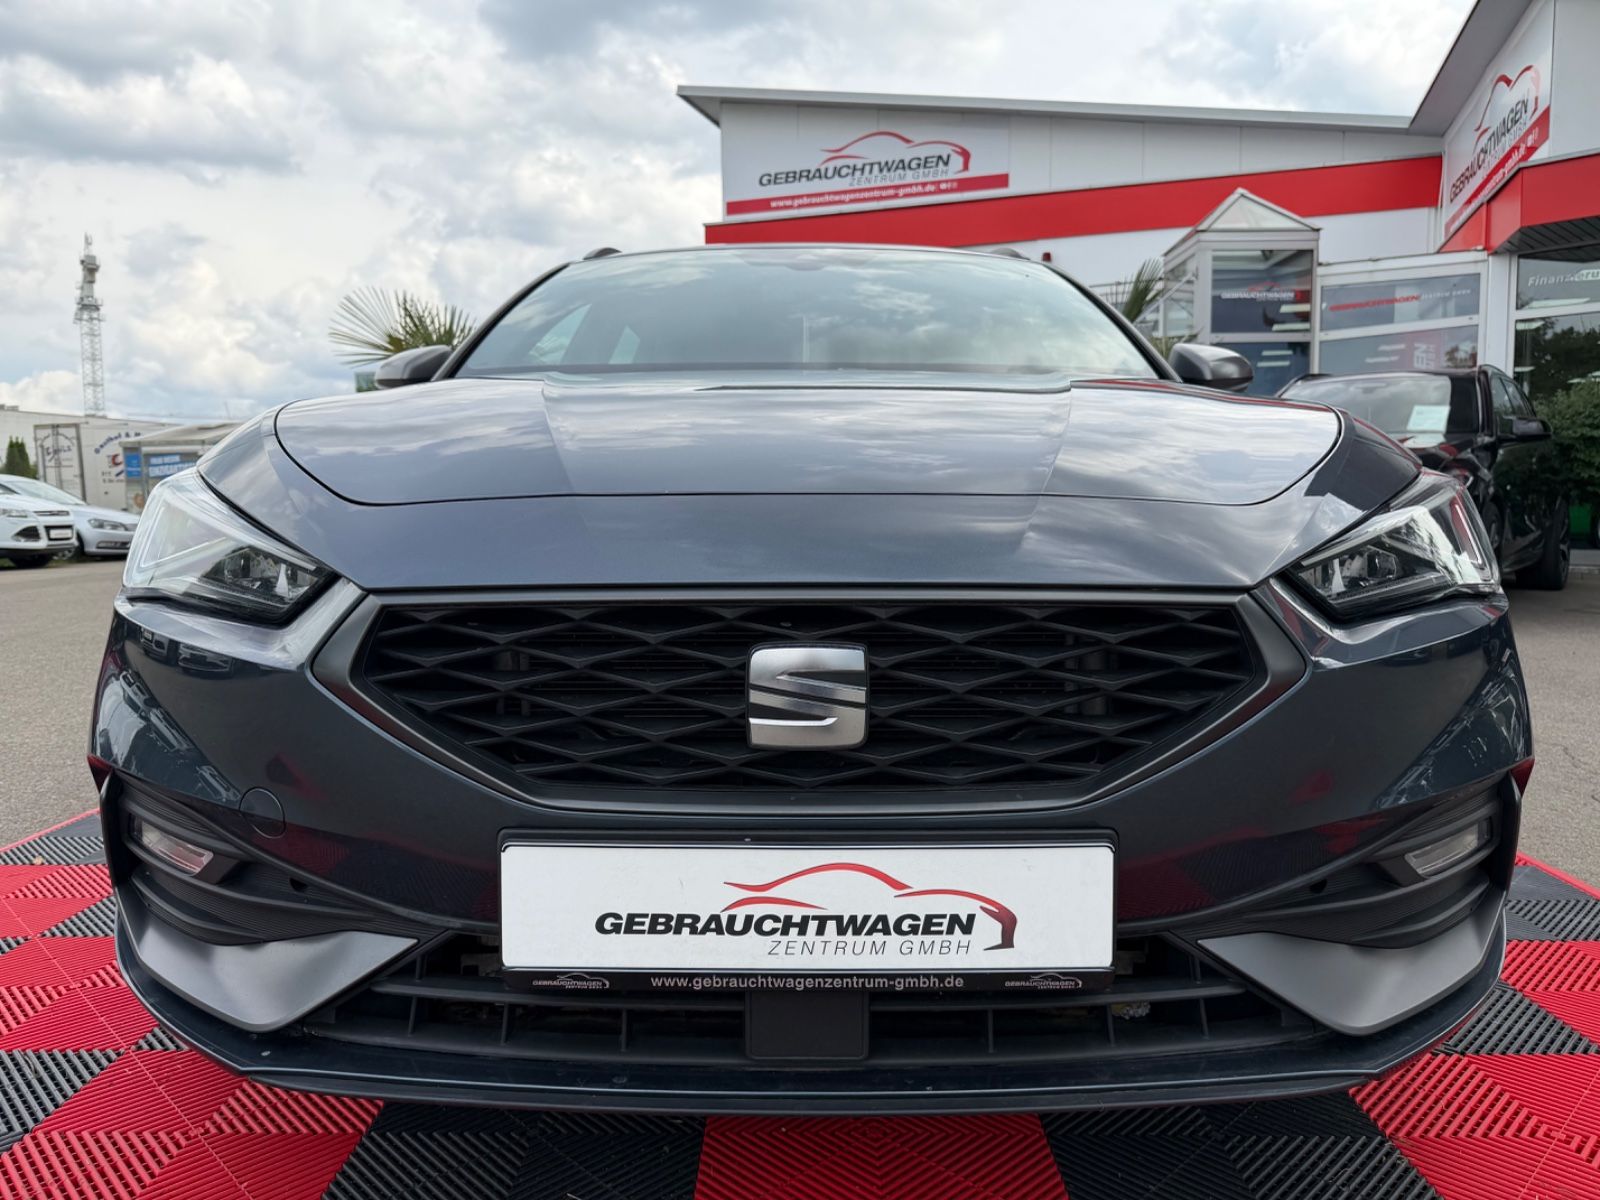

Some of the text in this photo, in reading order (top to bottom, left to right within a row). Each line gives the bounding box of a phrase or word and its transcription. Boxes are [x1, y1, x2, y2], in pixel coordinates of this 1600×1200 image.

[758, 153, 952, 187] GEBRAUCHTWAGEN
[848, 167, 950, 187] ZENTRUM GMBH
[595, 912, 976, 936] GEBRAUCHTWAGEN
[767, 940, 971, 956] ZENTRUM GMBH
[650, 975, 965, 991] www.gebrauchtwagenzentrum-gmbh.de
